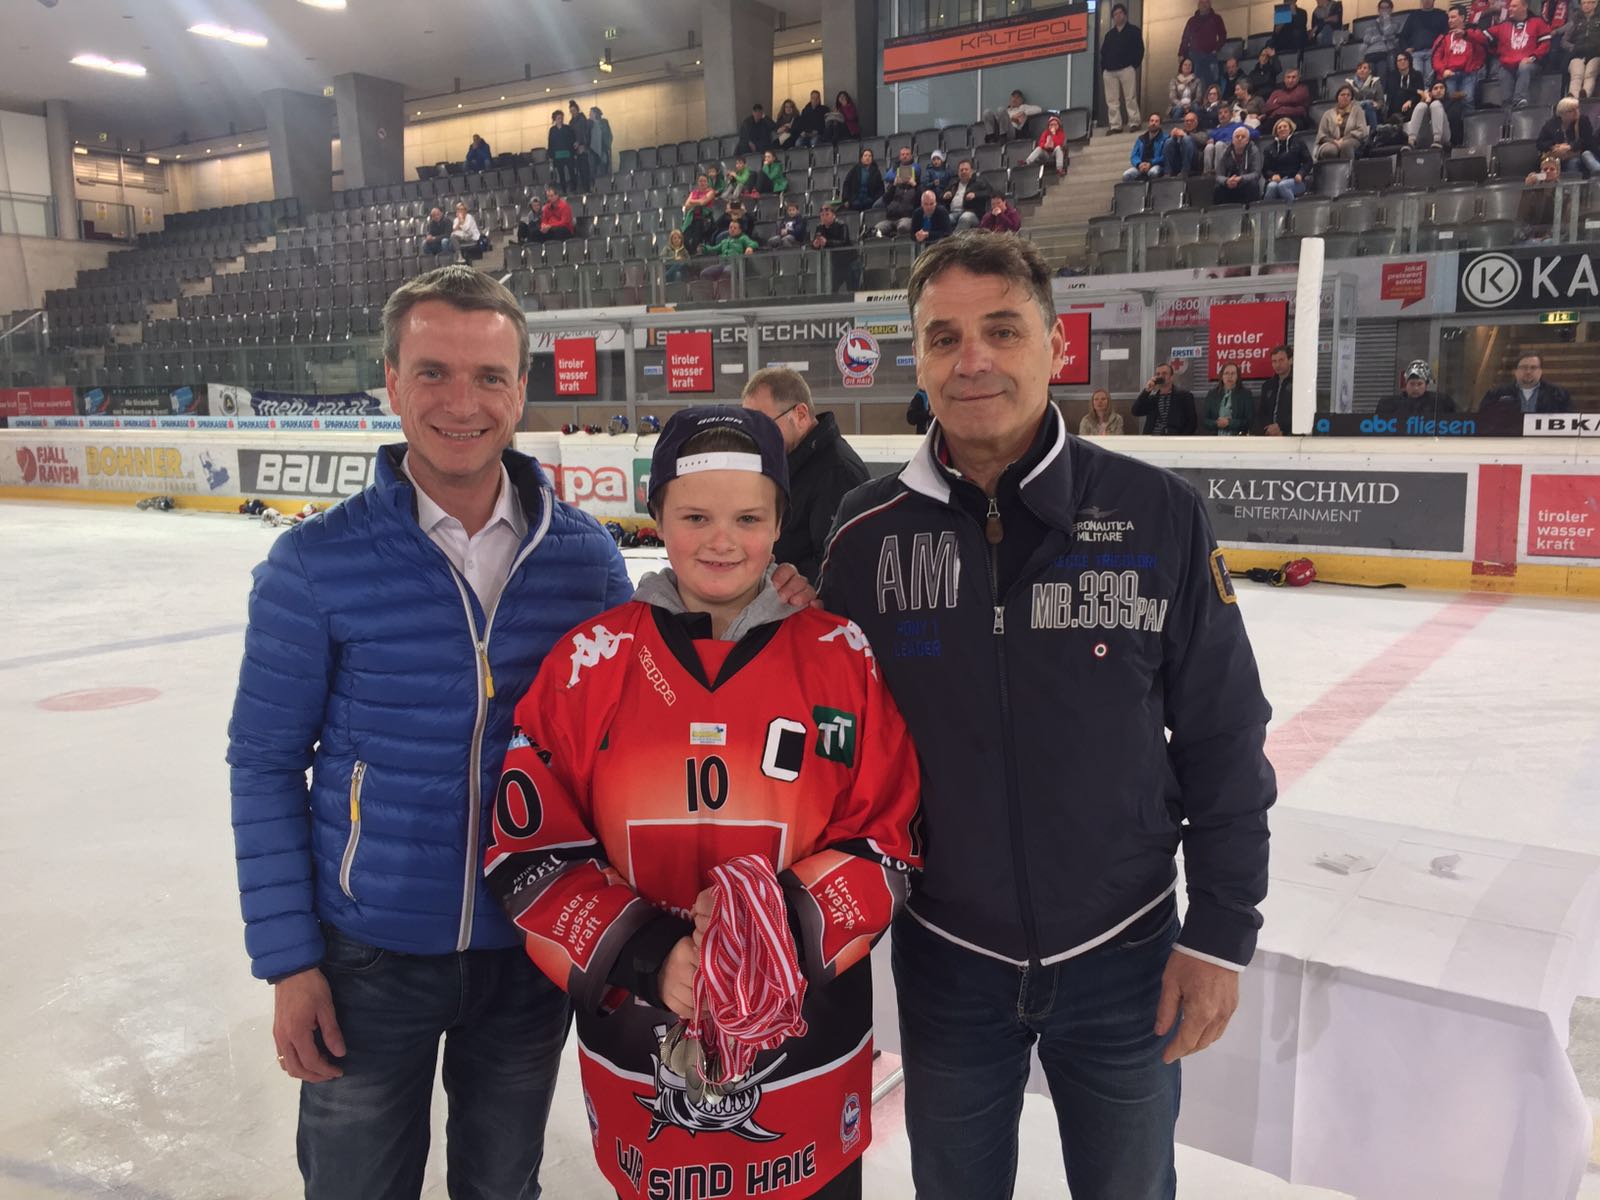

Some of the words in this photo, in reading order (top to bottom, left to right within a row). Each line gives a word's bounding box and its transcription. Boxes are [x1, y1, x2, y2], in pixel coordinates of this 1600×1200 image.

[960, 19, 1082, 51] KÄLTEPOL
[1216, 331, 1264, 345] tiroler
[671, 355, 700, 365] tiroler
[1216, 347, 1269, 360] wasser
[558, 359, 585, 369] tiroler
[559, 370, 589, 380] wasser
[671, 367, 704, 377] wasser
[559, 382, 580, 391] kraft
[672, 377, 694, 388] kraft
[123, 420, 151, 428] SPARKASSE
[160, 420, 189, 428] SPARKASSE
[197, 420, 228, 429] SPARKASSE
[237, 420, 270, 429] SPARKASSE
[280, 420, 313, 429] SPARKASSE
[324, 420, 360, 430] SPARKASSE
[371, 420, 402, 431] SPARKAS
[1360, 415, 1398, 433] abc
[1406, 415, 1476, 435] fliesen
[1207, 478, 1400, 505] KALTSCHMID
[1234, 505, 1362, 523] ENTERTAINMENT
[1537, 509, 1589, 524] tiroler
[1072, 520, 1135, 532] ERONAUTICA
[1536, 525, 1595, 538] wasser
[1076, 532, 1123, 542] MILITARE
[1535, 537, 1575, 551] kraft
[876, 531, 962, 614] AM
[639, 645, 677, 706] Kappa
[760, 716, 807, 783] C
[686, 754, 730, 812] 10
[834, 876, 866, 922] tiroler
[552, 894, 584, 937] tiroler
[567, 895, 600, 945] wasser
[574, 917, 602, 956] kraft
[648, 1162, 734, 1200] SIND
[746, 1141, 816, 1196] HAIE
